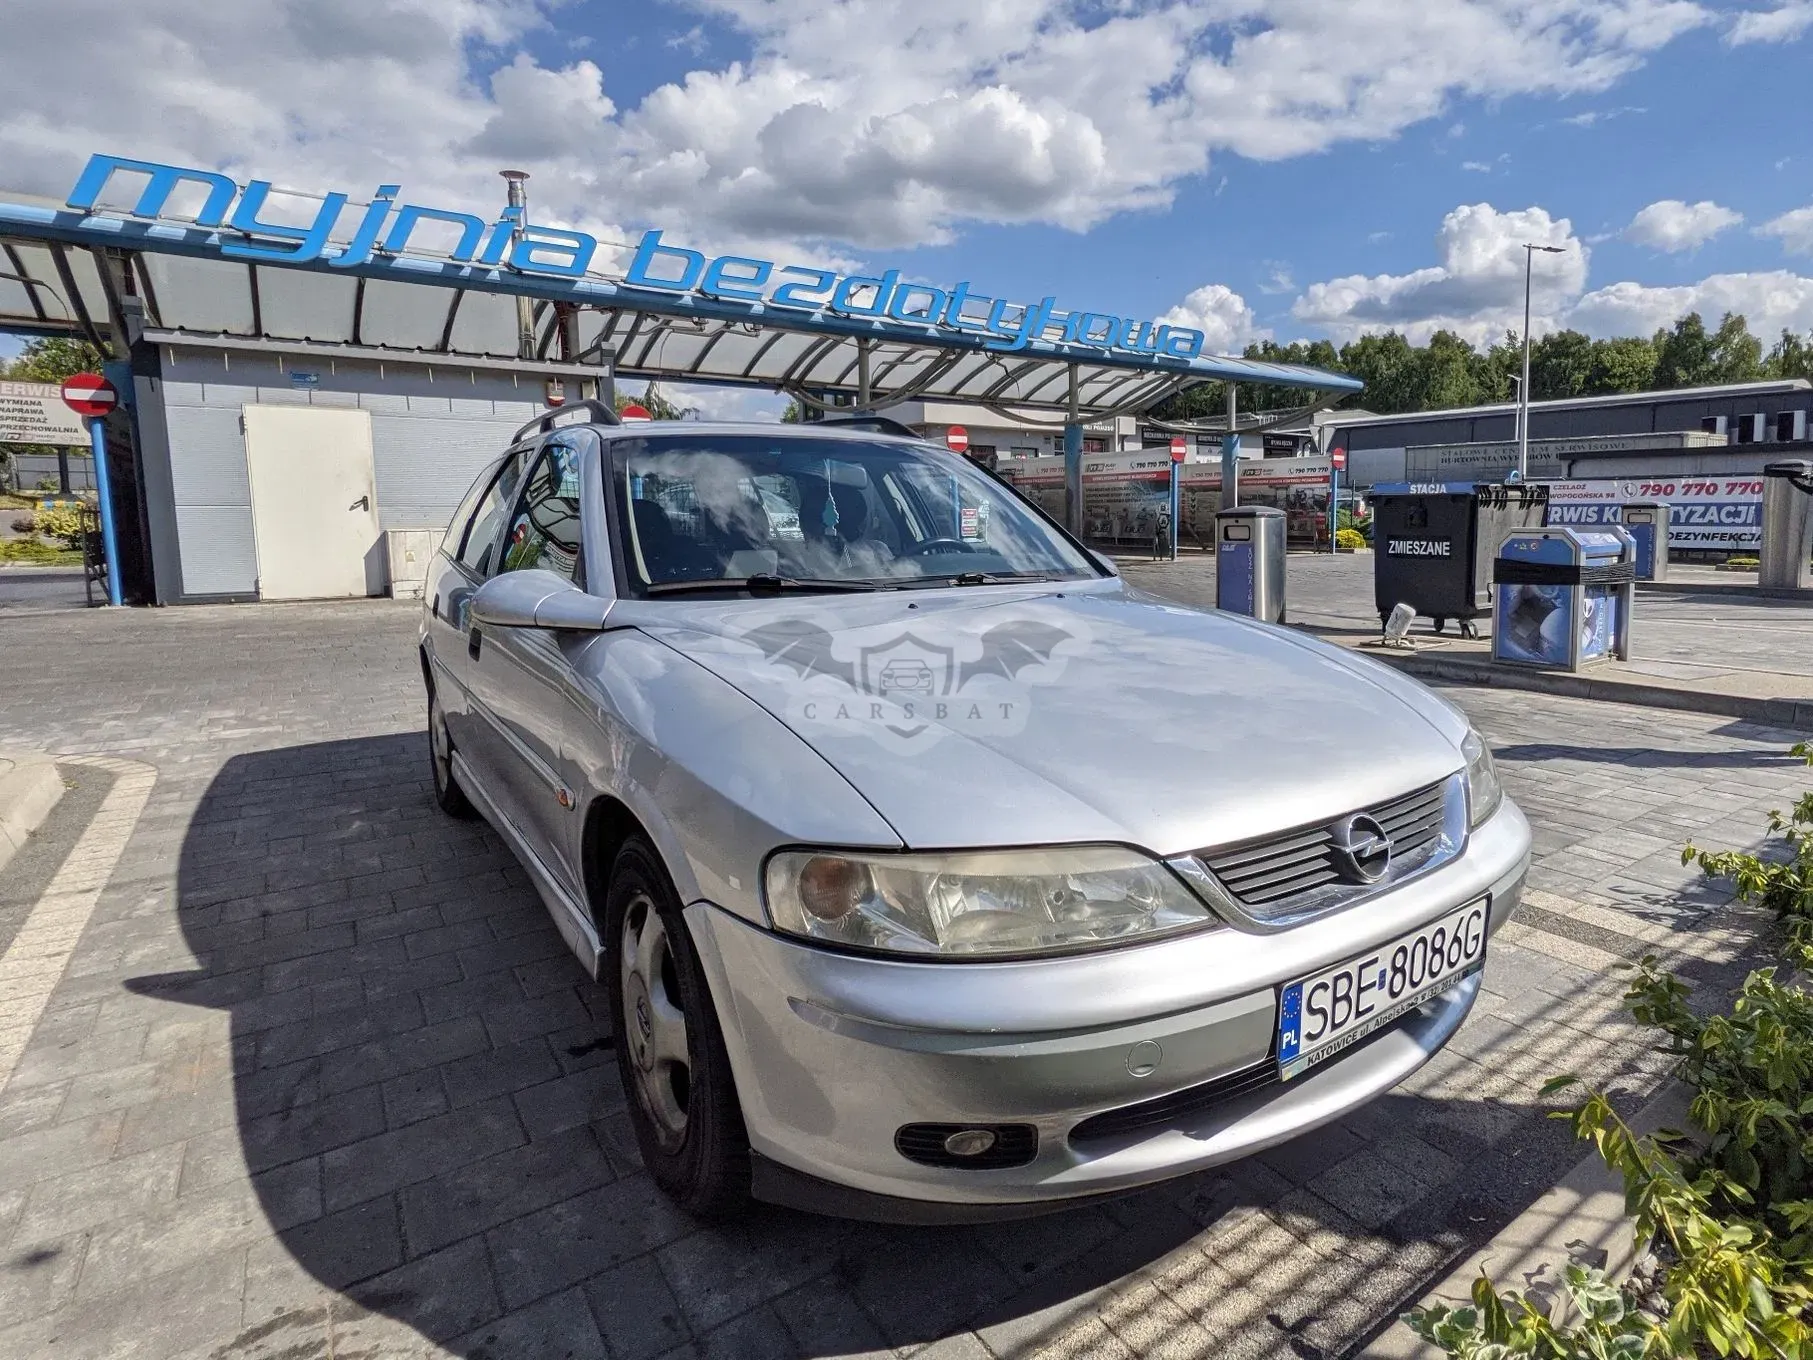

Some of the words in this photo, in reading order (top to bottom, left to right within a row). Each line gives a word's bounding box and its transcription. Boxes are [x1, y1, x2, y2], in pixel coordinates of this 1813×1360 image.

[67, 153, 598, 277] myjnia
[625, 229, 1204, 358] bezdotykowa
[1409, 483, 1447, 494] STACJA
[1640, 483, 1675, 497] 790
[1682, 483, 1719, 496] 770
[1725, 482, 1764, 495] 770
[1388, 541, 1450, 556] ZMIESZANE
[1304, 957, 1379, 1042] SBE
[1388, 909, 1482, 1000] 8086G
[1282, 1031, 1298, 1050] PL
[1307, 1032, 1358, 1065] KATOWICE
